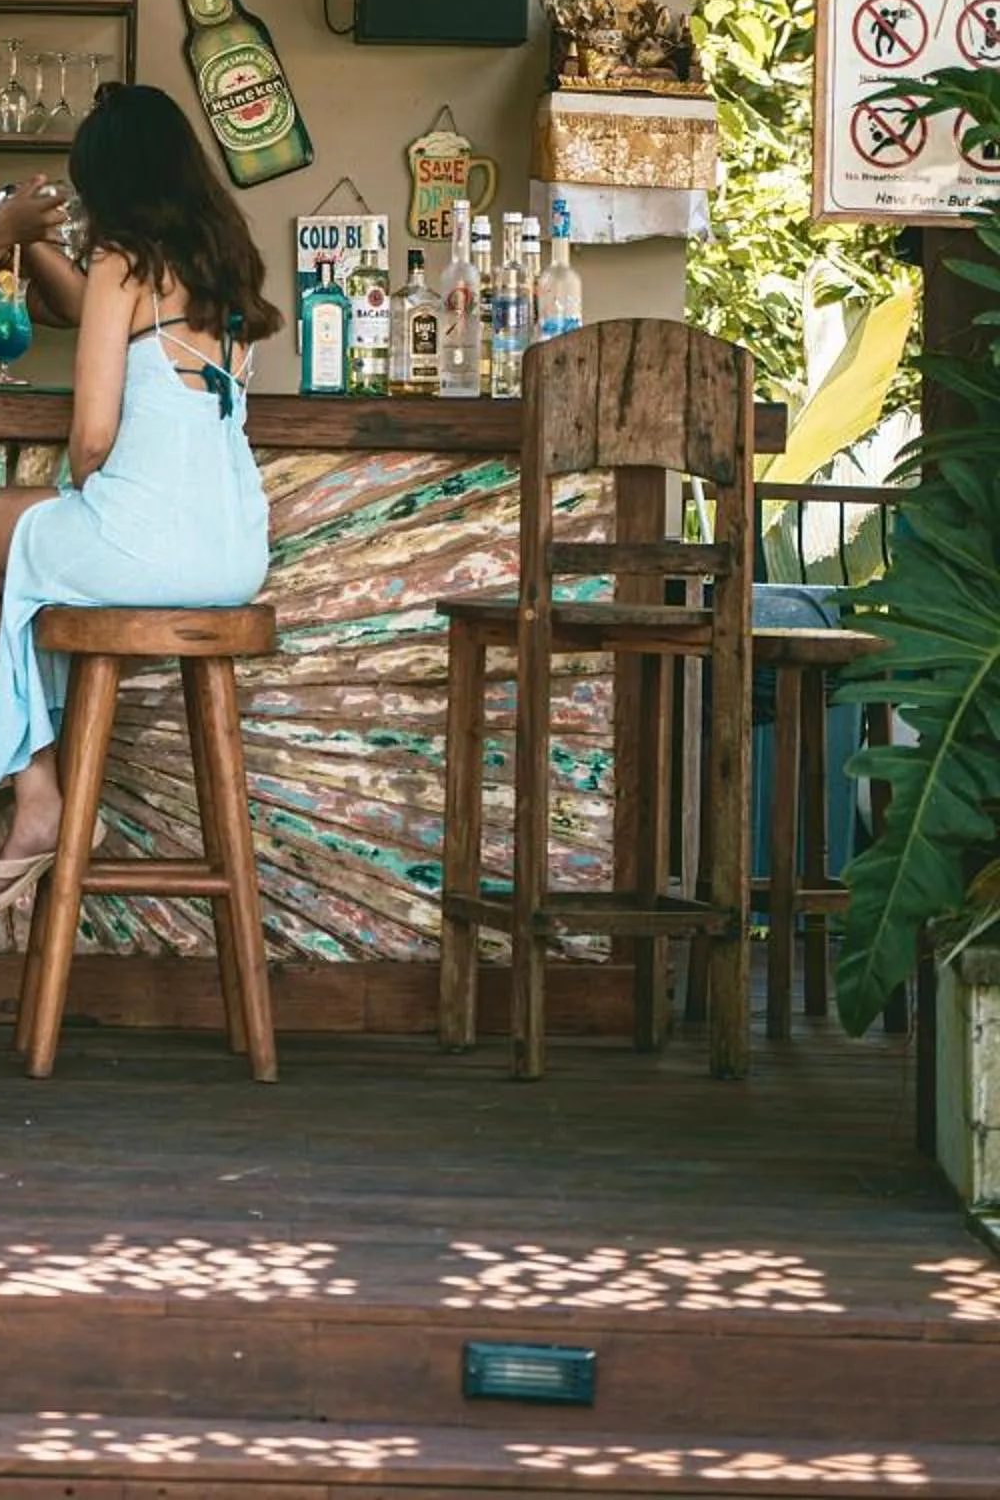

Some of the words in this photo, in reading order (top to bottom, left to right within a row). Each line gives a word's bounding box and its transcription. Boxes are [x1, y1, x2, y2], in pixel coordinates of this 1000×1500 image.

[211, 81, 283, 113] Heineken
[419, 159, 465, 184] SAVE
[947, 195, 970, 207] But
[300, 225, 340, 249] COLD
[417, 210, 453, 239] BEE
